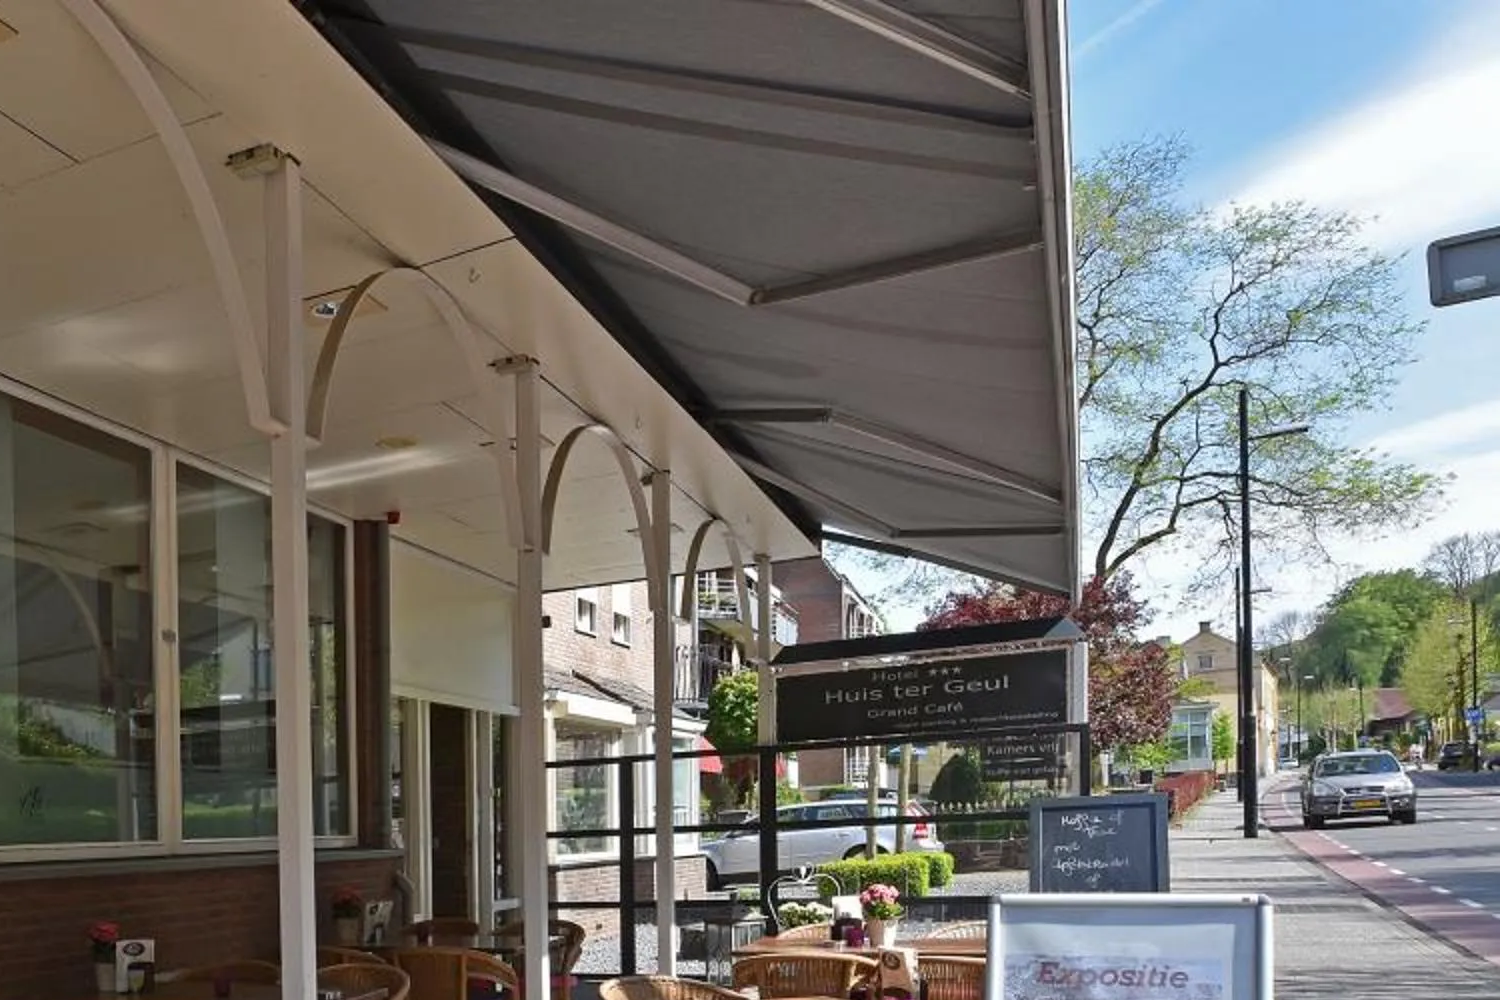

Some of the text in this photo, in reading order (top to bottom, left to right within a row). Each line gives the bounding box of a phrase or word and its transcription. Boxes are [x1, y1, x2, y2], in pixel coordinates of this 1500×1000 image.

[871, 670, 919, 682] Hotel
[824, 675, 1010, 704] Huis ter Geul
[867, 701, 964, 719] Grand Café
[1035, 961, 1190, 990] Expositie
